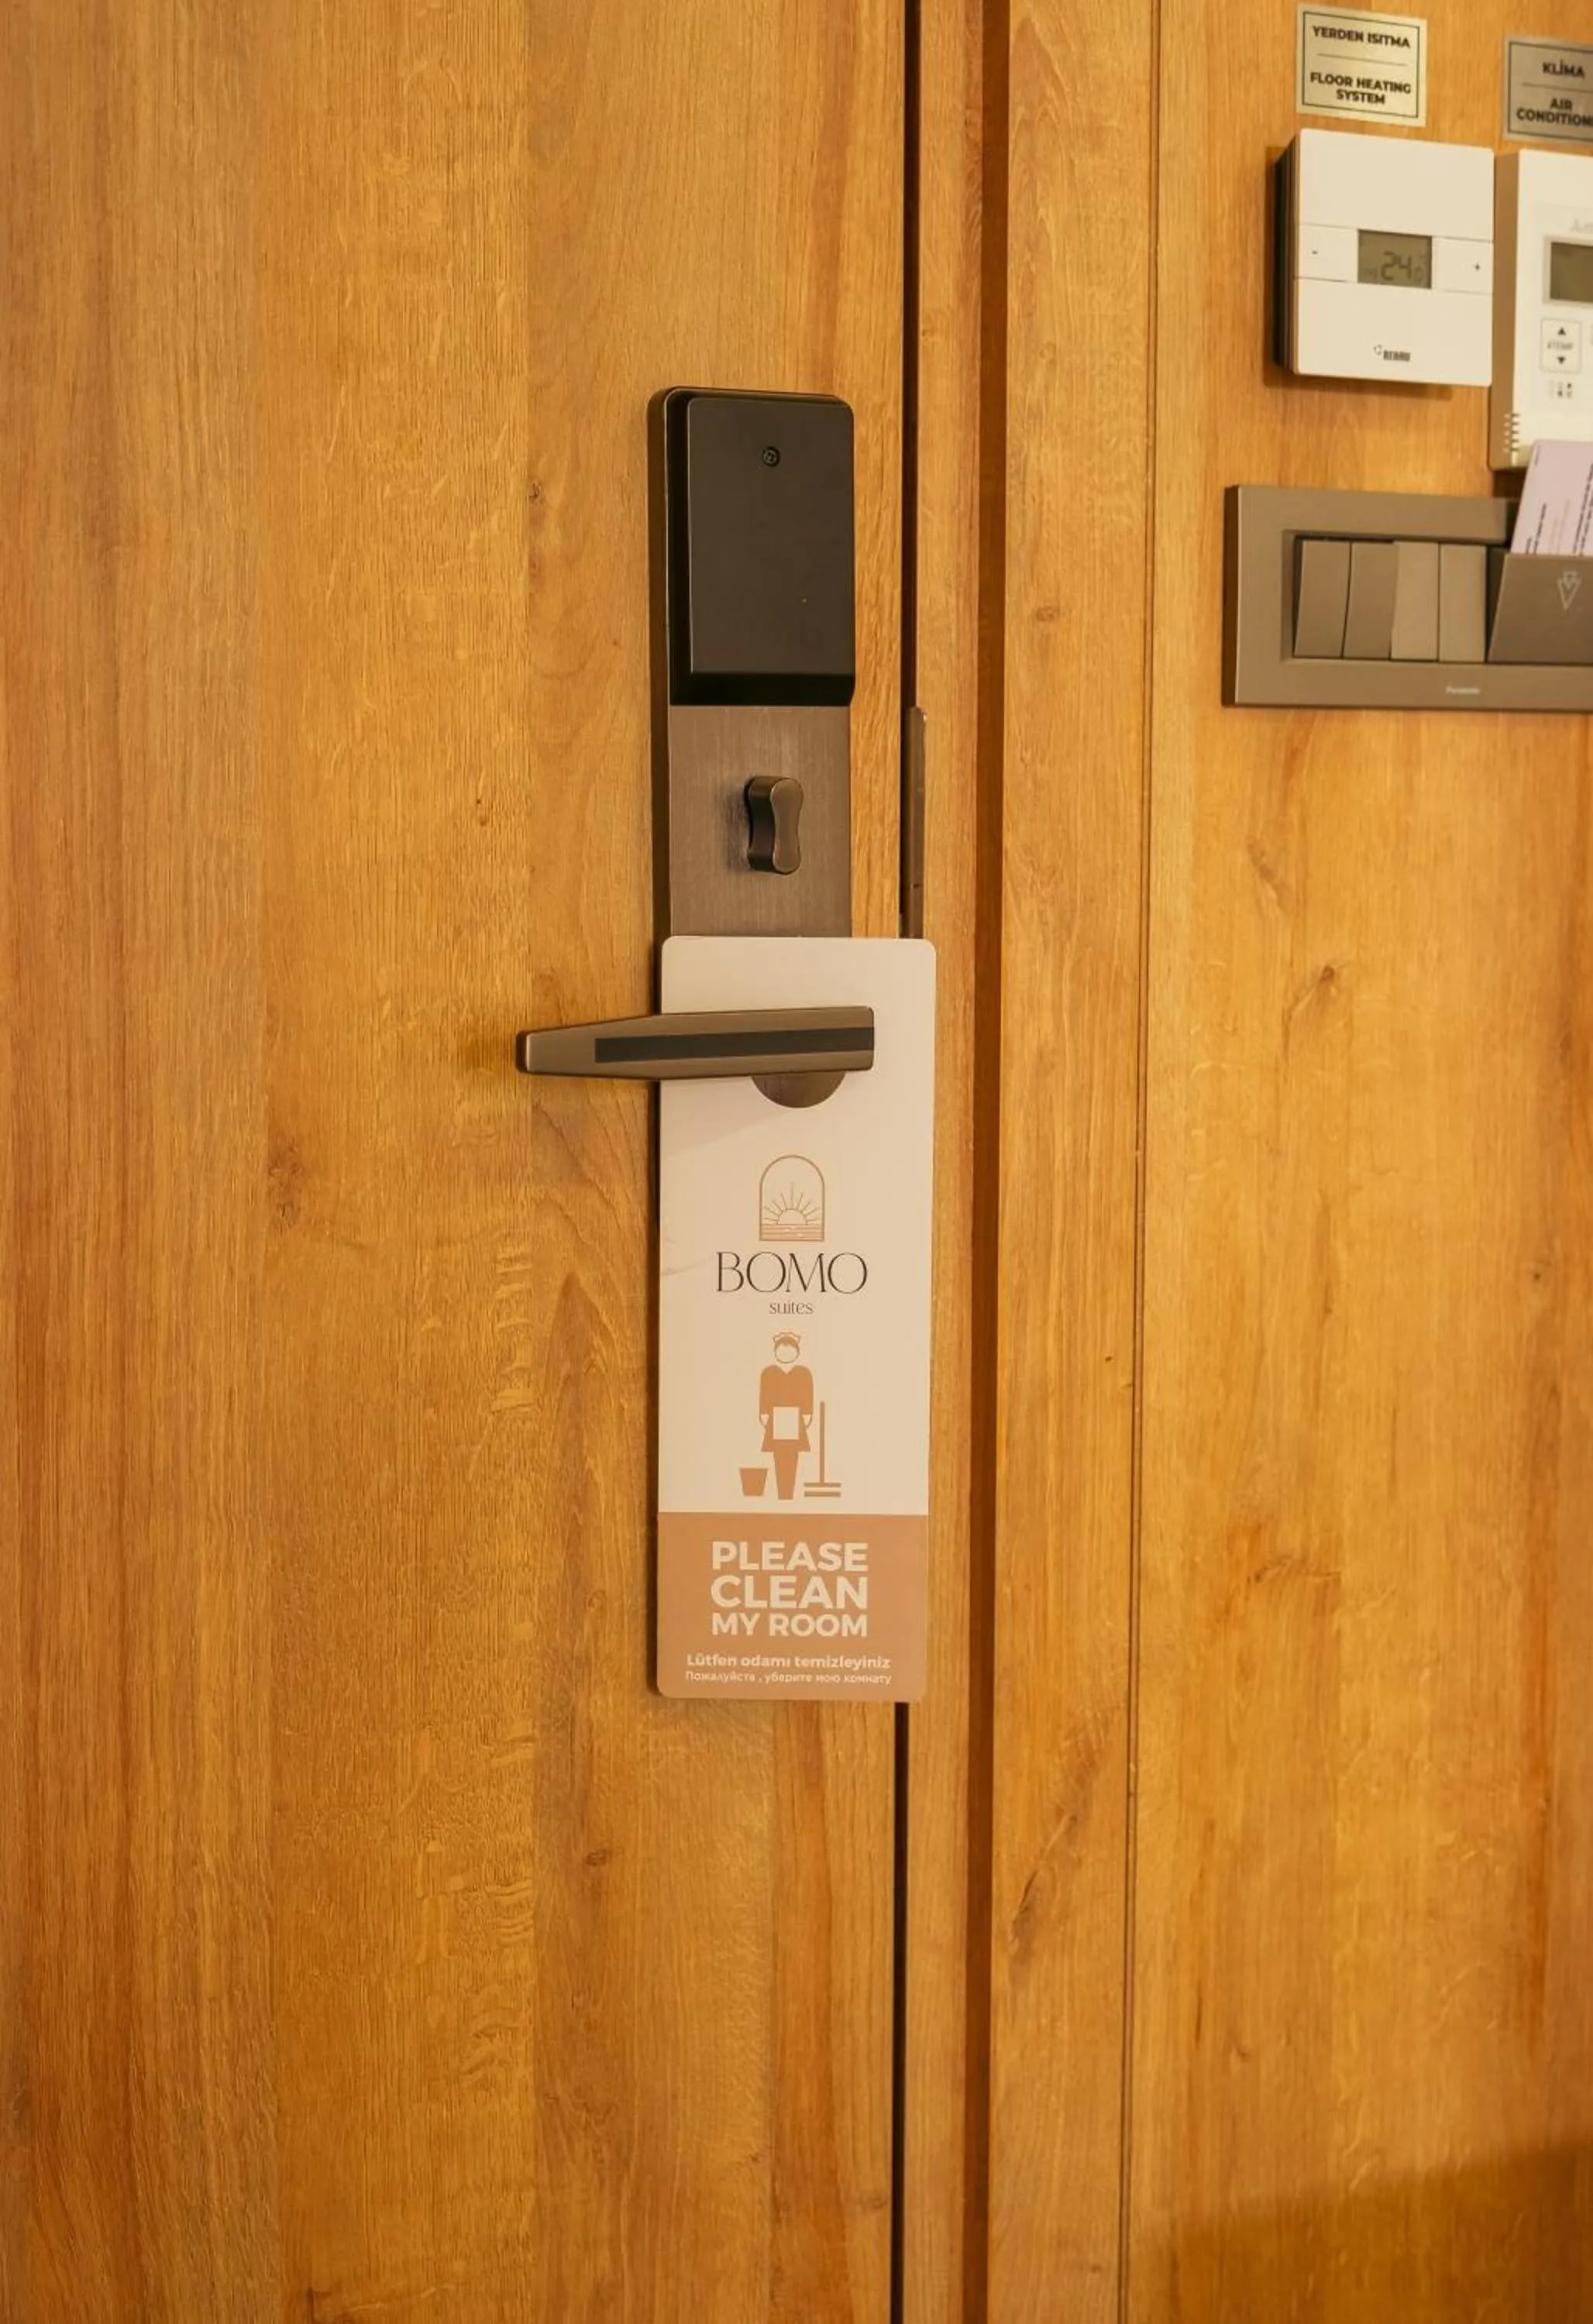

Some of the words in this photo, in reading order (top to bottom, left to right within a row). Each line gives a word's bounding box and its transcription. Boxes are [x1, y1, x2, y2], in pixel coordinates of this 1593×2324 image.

[1312, 26, 1364, 43] YERDEN
[1368, 33, 1410, 48] ISITMA
[1543, 60, 1585, 78] KLİMA
[1311, 72, 1353, 88] FLOOR
[1357, 78, 1411, 94] HEATING
[1337, 90, 1385, 105] SYSTEM
[1550, 98, 1572, 110] AIR
[717, 1251, 868, 1294] BOMO
[769, 1300, 814, 1315] suites
[711, 1541, 869, 1572] PLEASE
[710, 1575, 869, 1610] CLEAN
[712, 1612, 760, 1636] MY
[769, 1614, 867, 1638] ROOM
[687, 1653, 737, 1666] Lütfen
[740, 1654, 791, 1667] odamı
[794, 1655, 891, 1670] temizleyiniz
